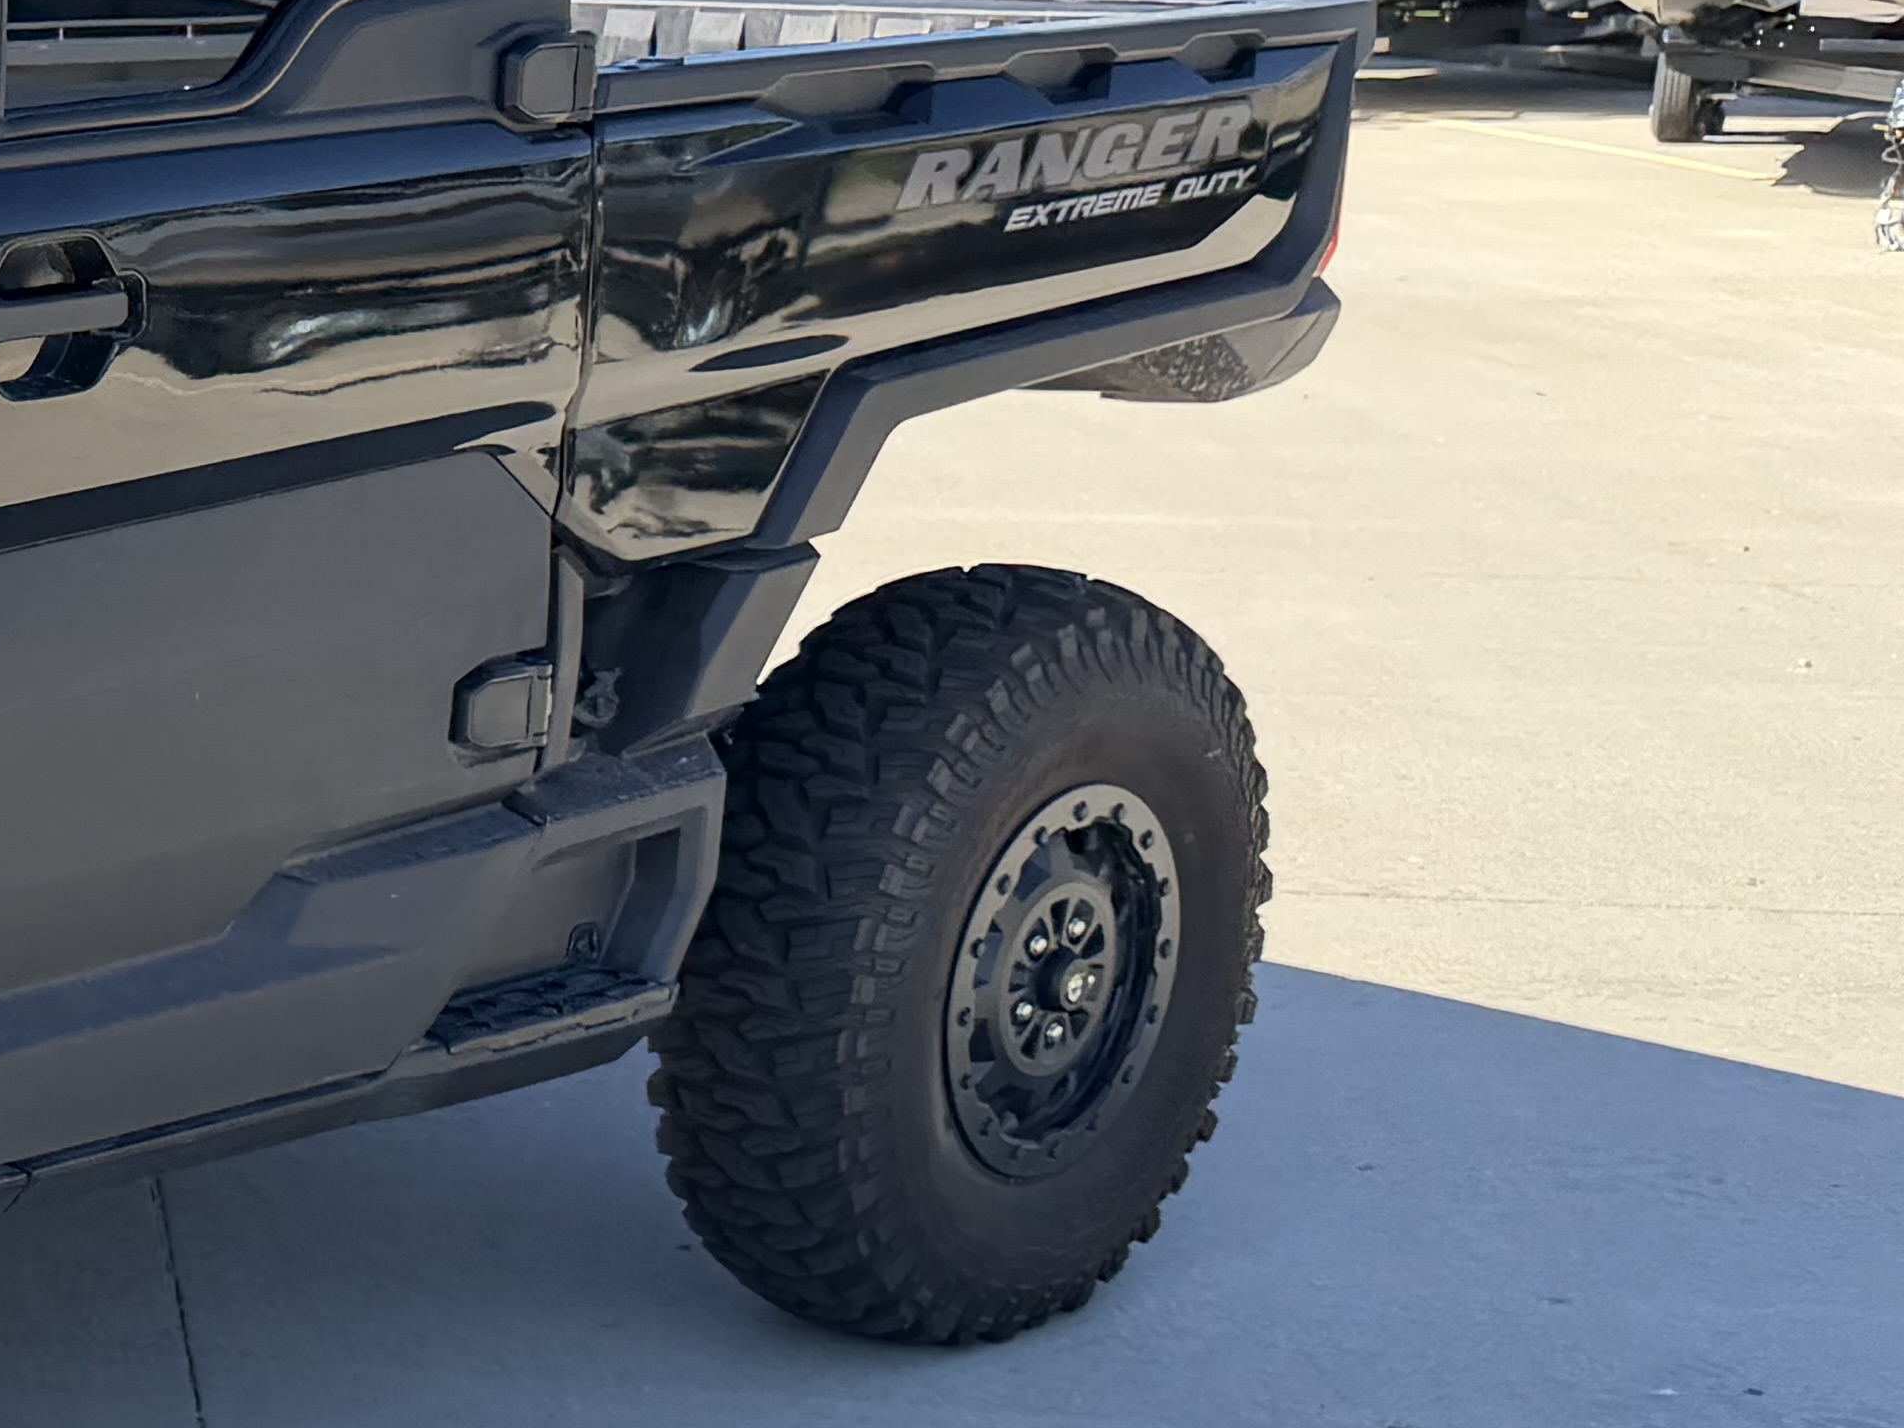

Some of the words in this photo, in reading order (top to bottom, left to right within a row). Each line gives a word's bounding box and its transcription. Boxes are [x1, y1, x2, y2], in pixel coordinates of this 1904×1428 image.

[896, 103, 1254, 210] RANGER
[1003, 181, 1166, 233] EXTREME
[1172, 165, 1257, 202] DUTY
